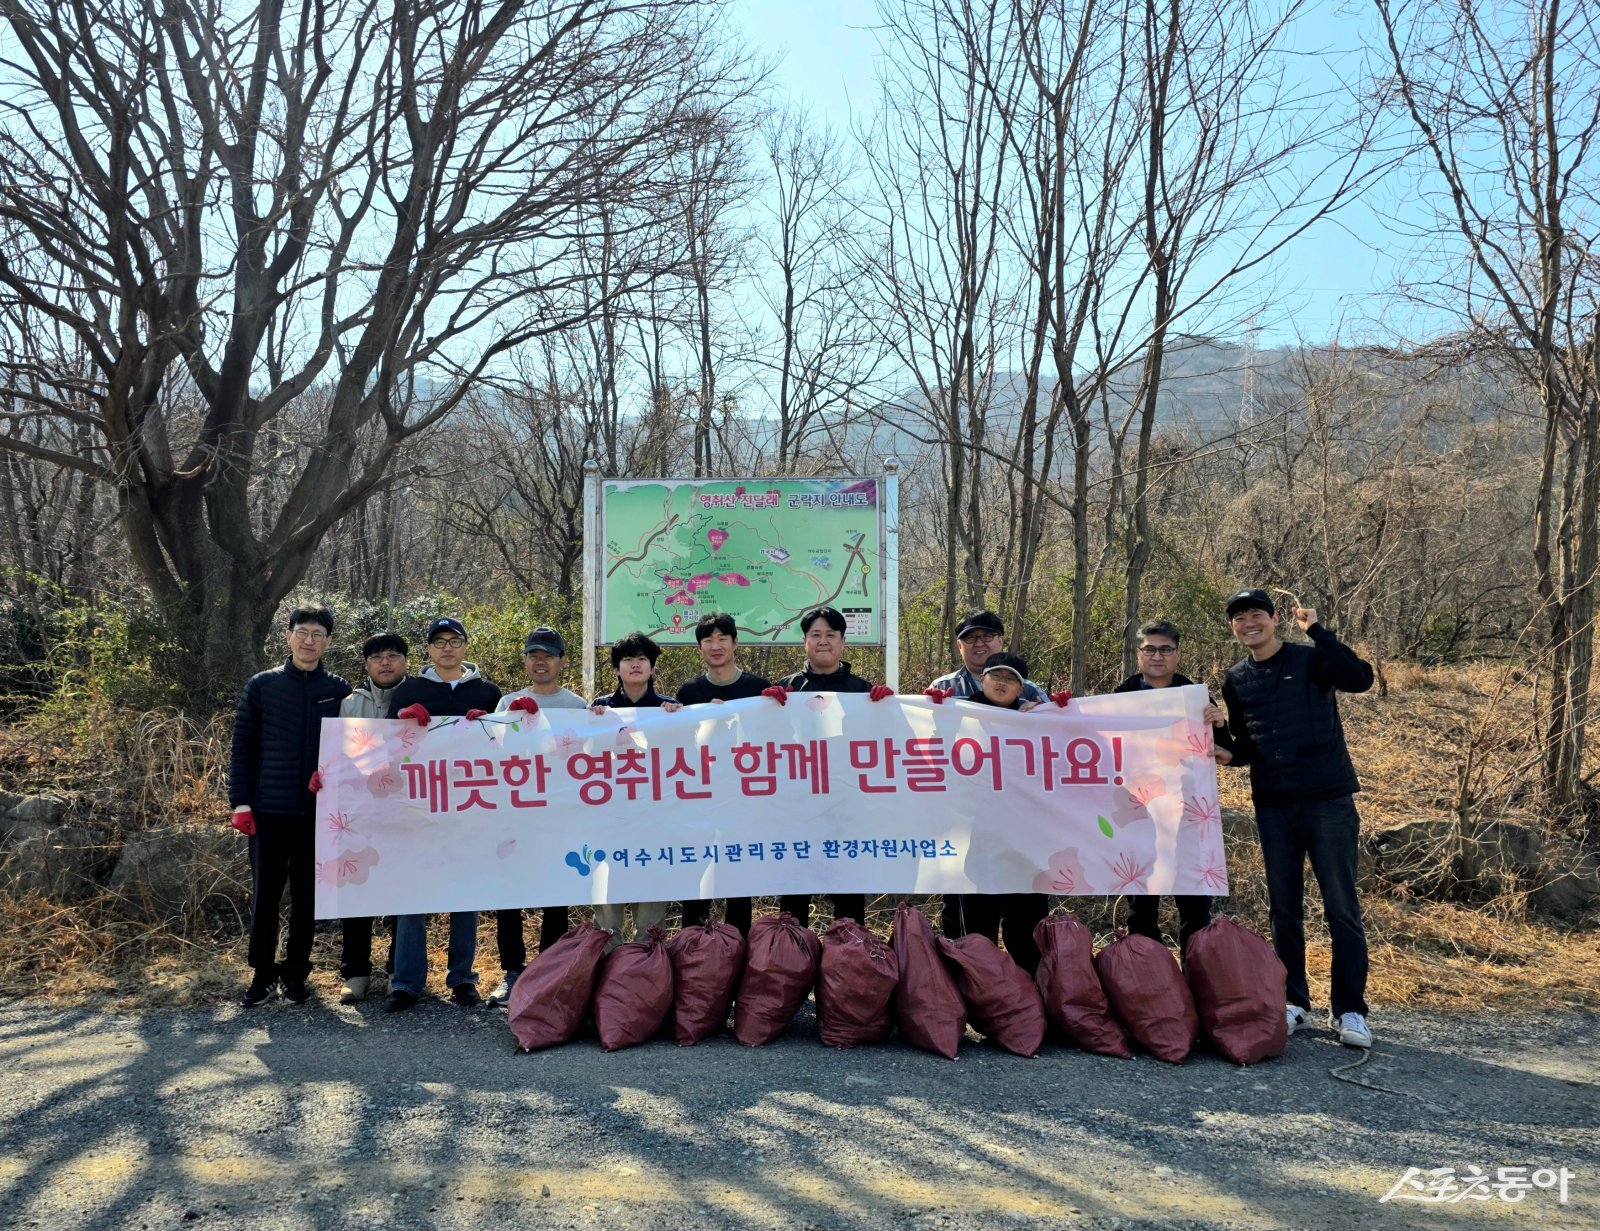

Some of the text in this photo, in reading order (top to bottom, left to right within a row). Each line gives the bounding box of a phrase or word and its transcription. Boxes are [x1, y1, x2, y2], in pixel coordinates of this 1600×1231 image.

[700, 493, 868, 508] 영취산 진달래 군락지 안내도
[401, 736, 1125, 814] 깨끗한 영취산 함께 만들어가요!
[612, 838, 958, 868] 여수시도시관리공단 환경자원사업소
